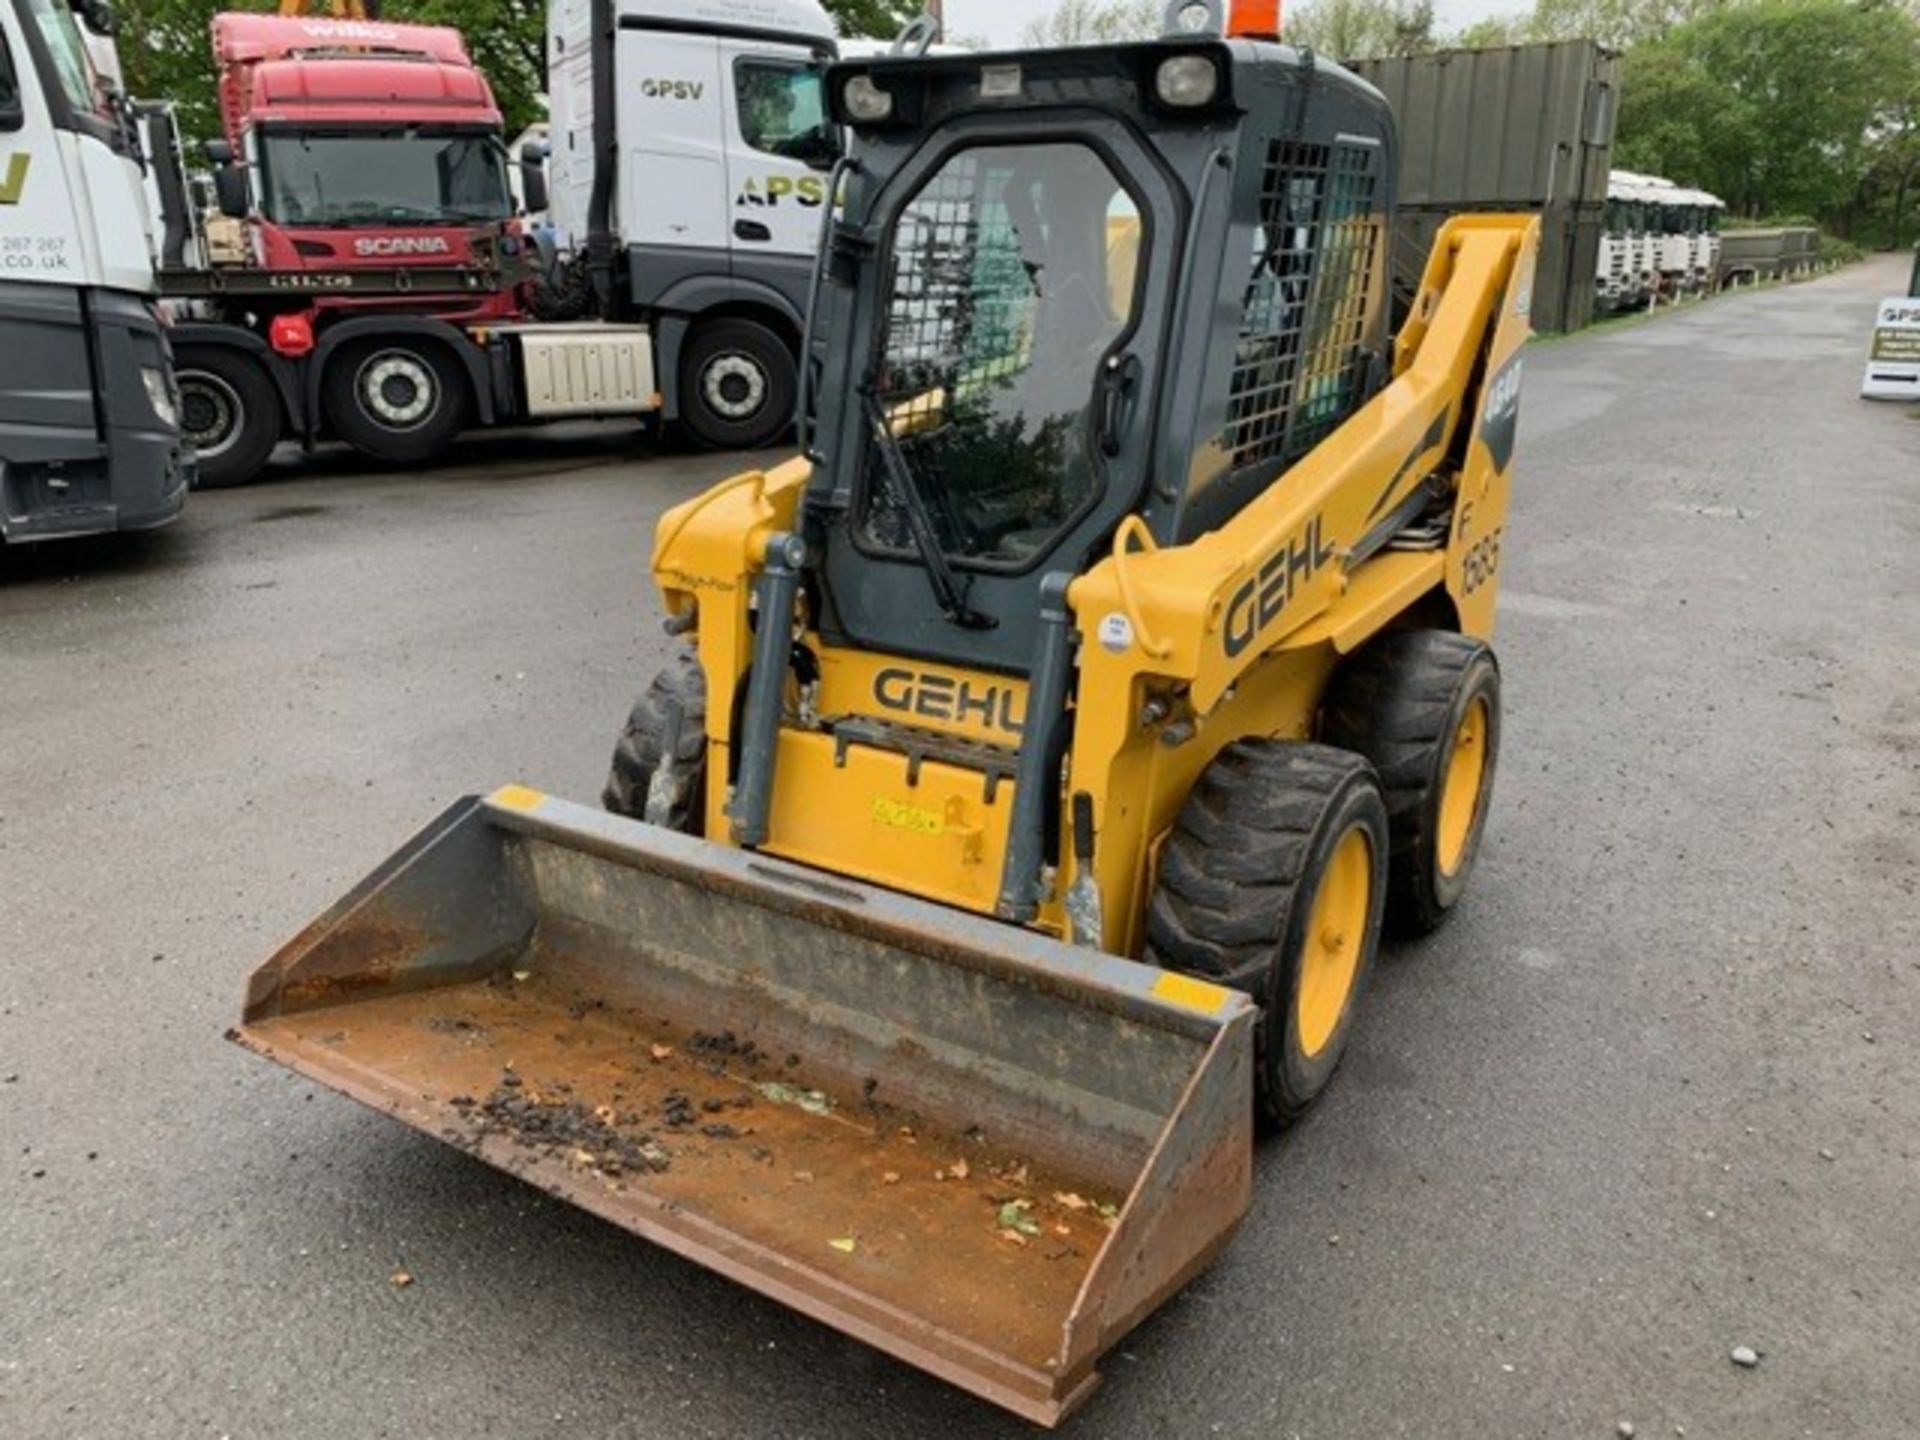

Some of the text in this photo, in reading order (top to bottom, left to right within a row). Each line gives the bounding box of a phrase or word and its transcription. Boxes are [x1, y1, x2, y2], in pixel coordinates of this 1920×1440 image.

[353, 236, 449, 255] SCANIA
[1223, 513, 1336, 658] GEHL
[875, 668, 1025, 732] GEHL
